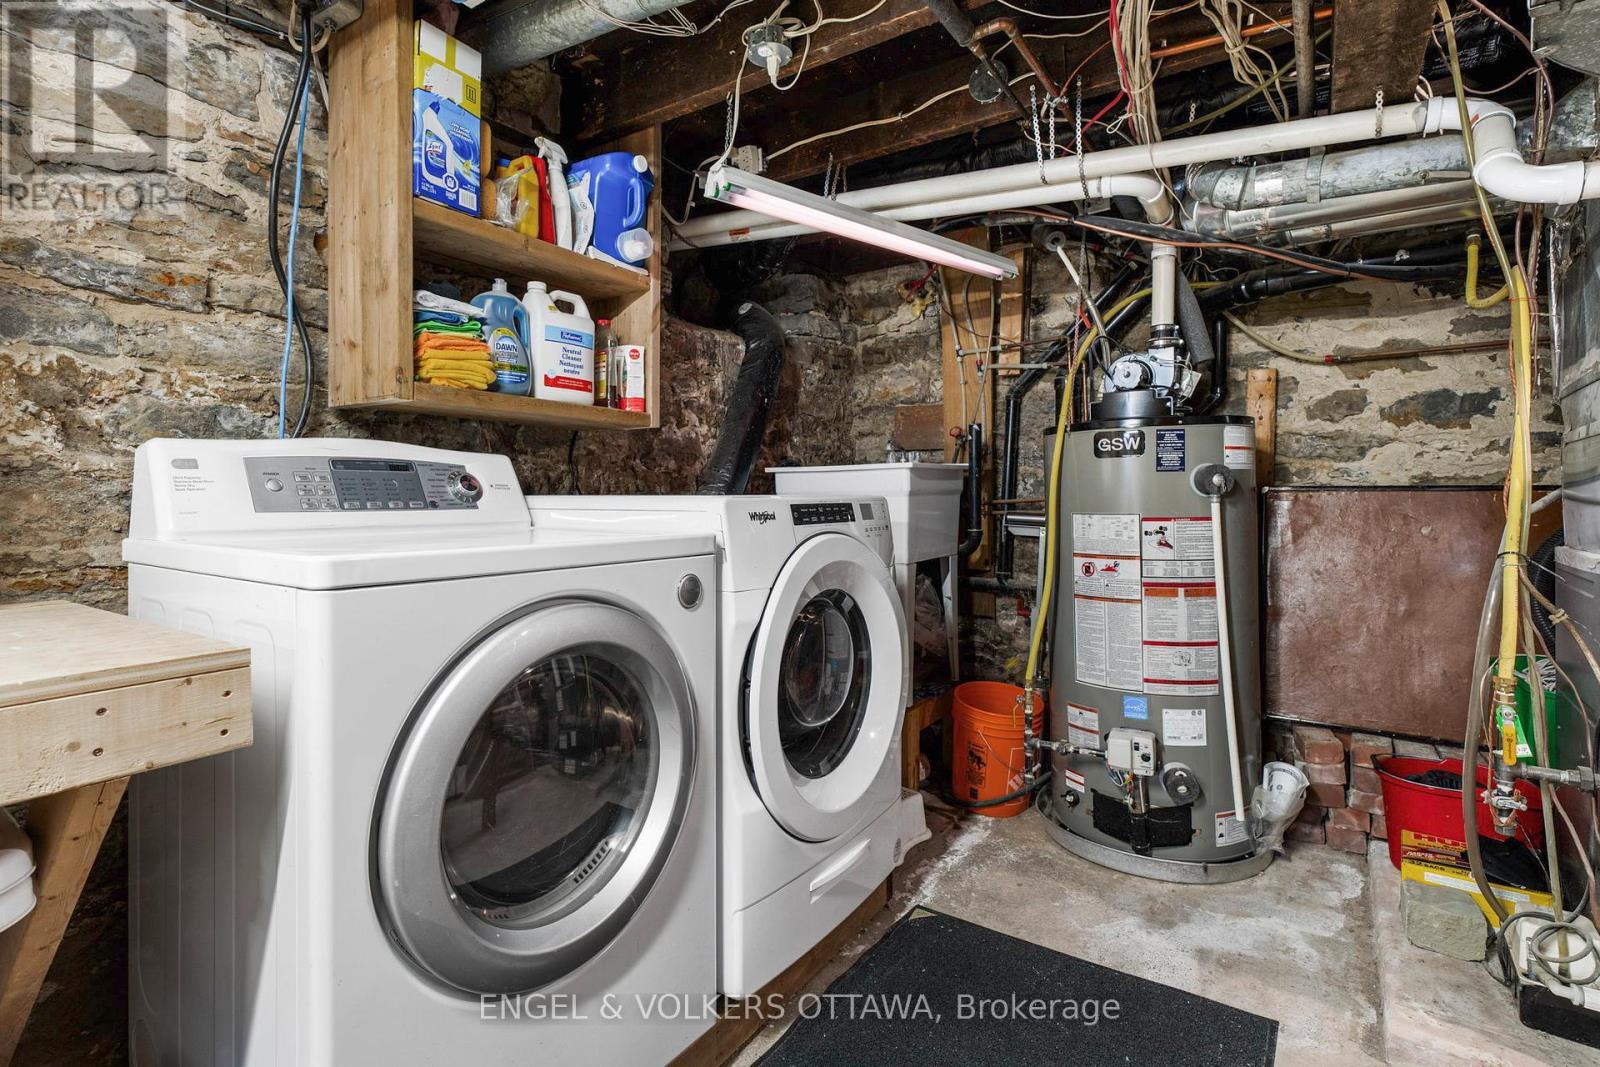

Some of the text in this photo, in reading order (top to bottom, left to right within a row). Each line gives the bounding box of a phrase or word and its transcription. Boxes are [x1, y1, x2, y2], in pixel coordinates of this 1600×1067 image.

[495, 342, 518, 353] DAWN
[1098, 436, 1140, 451] GSW
[748, 510, 777, 525] Whirlpool
